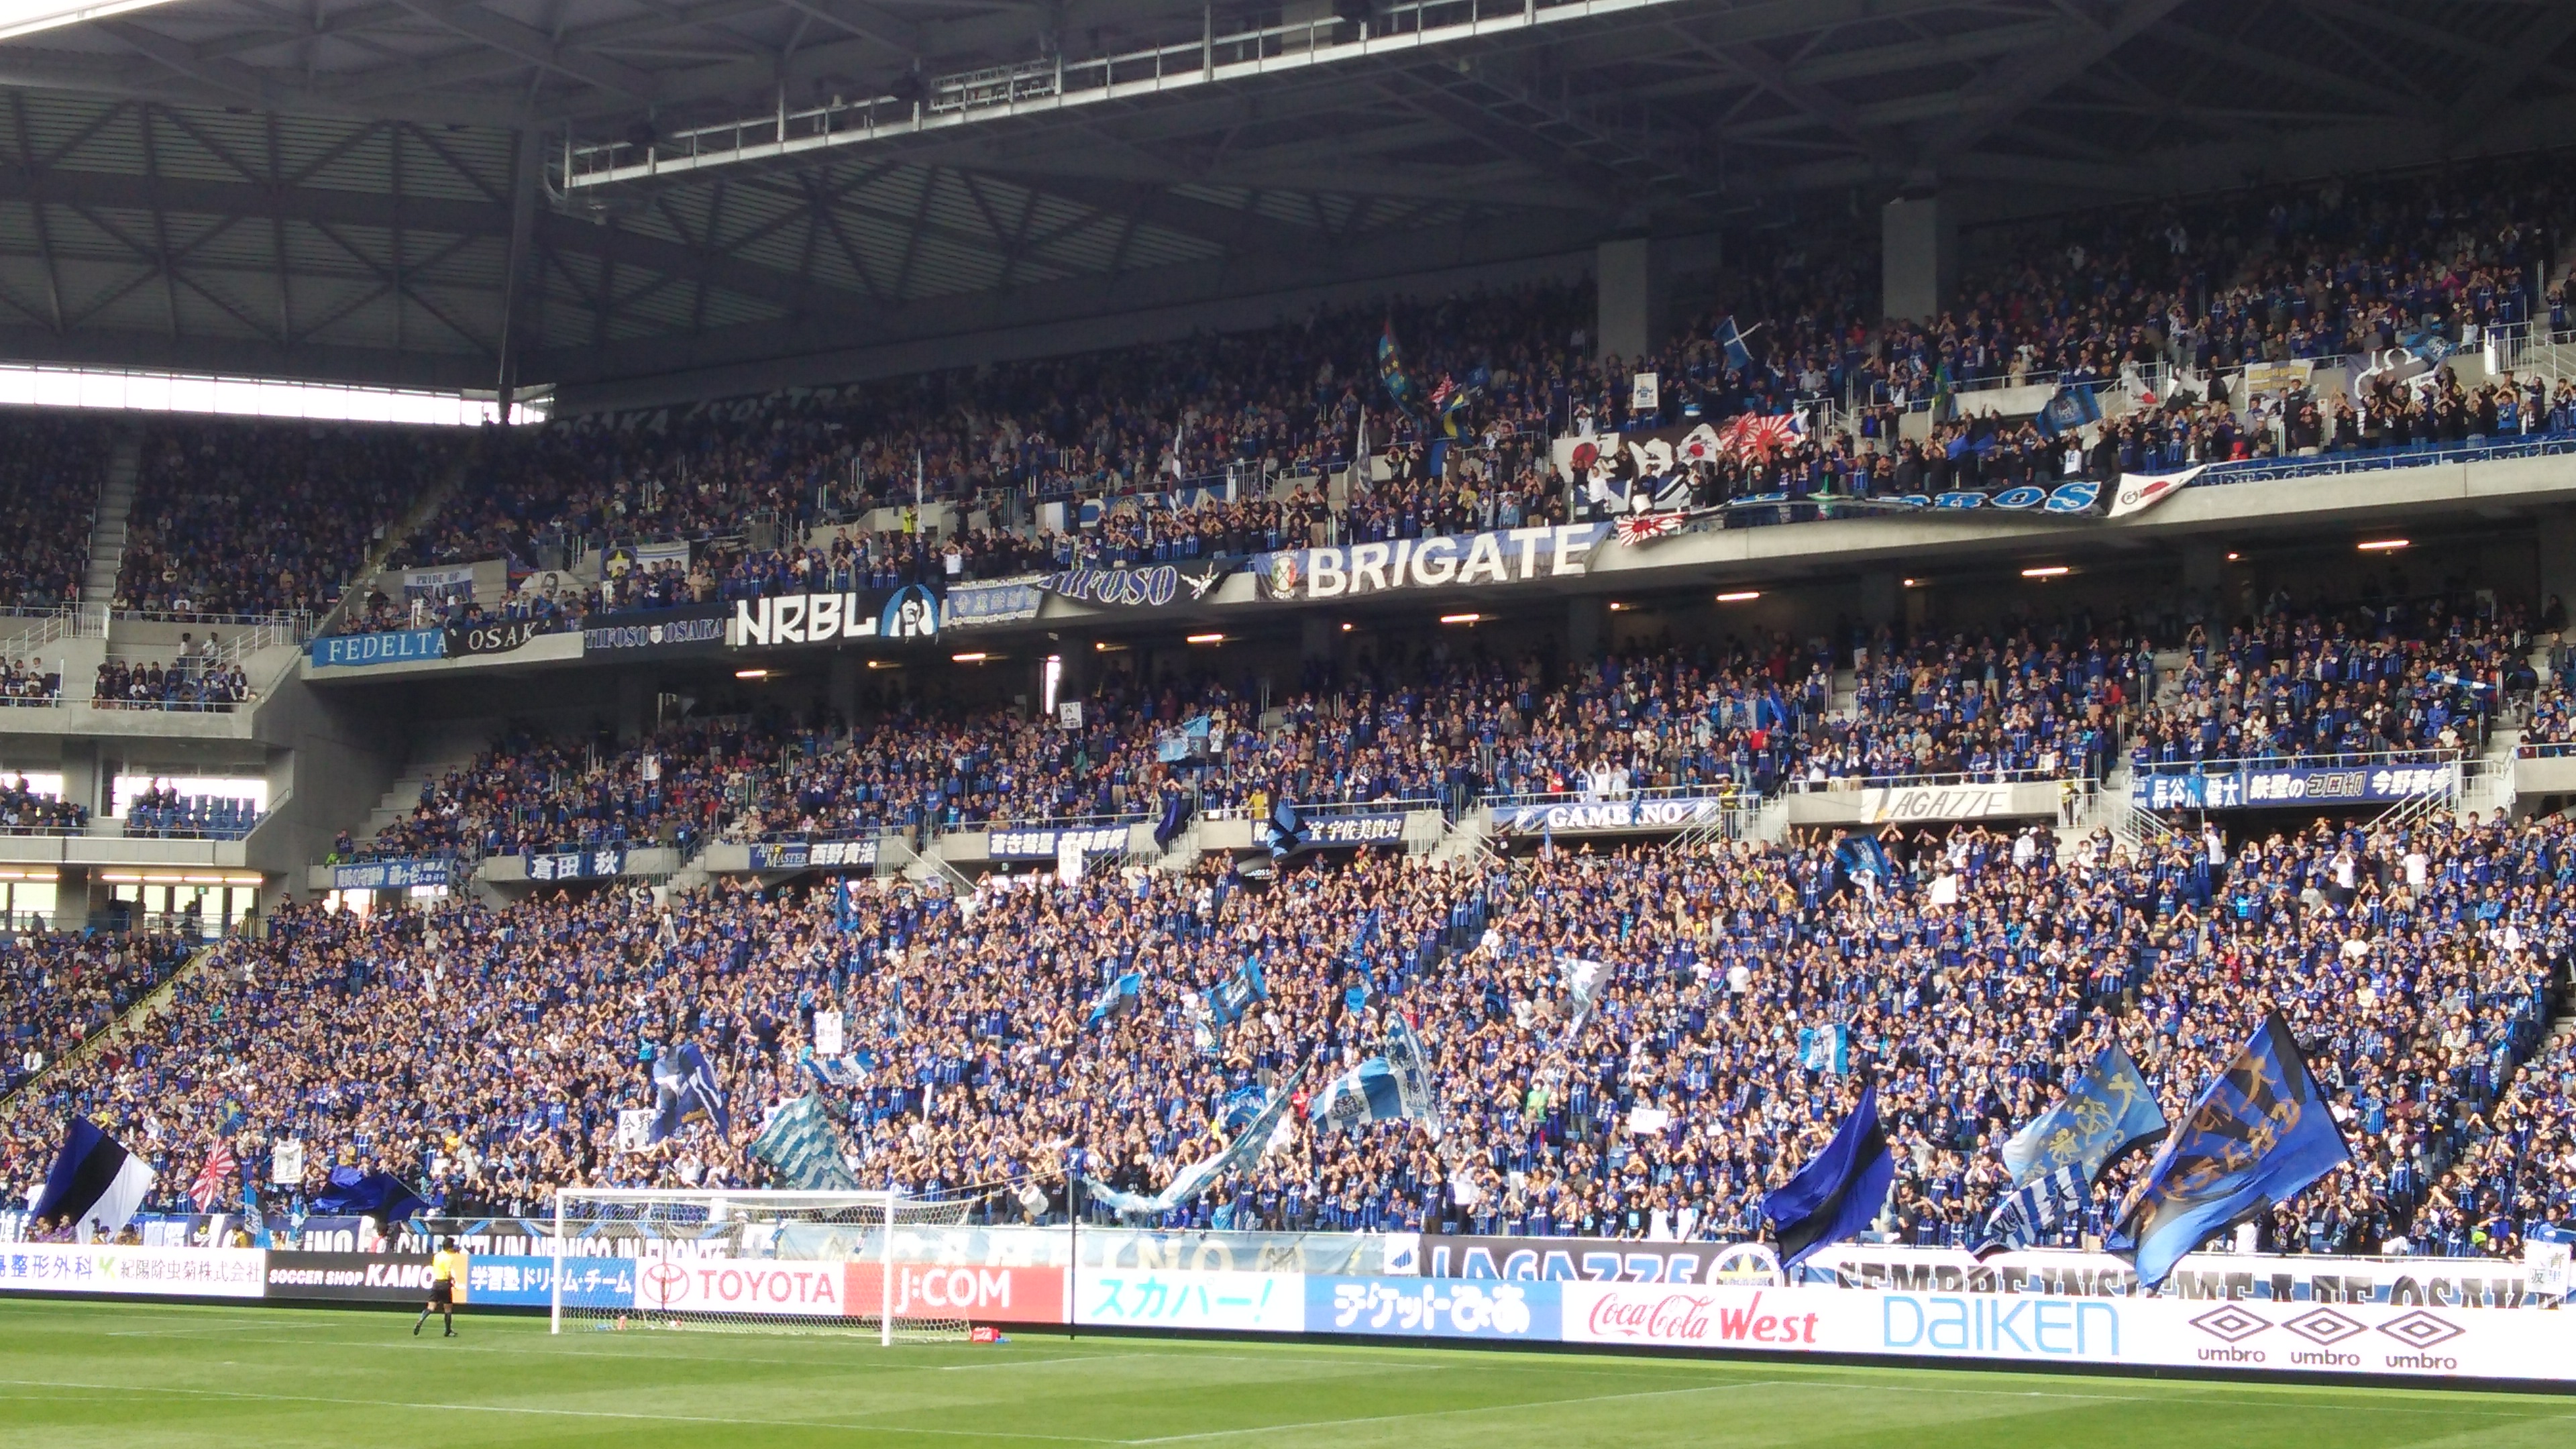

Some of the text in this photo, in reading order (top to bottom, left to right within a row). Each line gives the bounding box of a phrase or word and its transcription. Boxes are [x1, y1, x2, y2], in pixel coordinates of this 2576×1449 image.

[1308, 523, 1593, 597] BRIGATE
[417, 574, 444, 585] PRIDE
[737, 592, 876, 645] NRBL
[585, 617, 724, 649] TIFOSO OSAKA
[1548, 802, 1683, 828] GAMBNO
[1328, 818, 1401, 841] 宇佐美貴史
[594, 851, 620, 875] 秋
[121, 1257, 262, 1284] 紀陽除虫菊株式会社
[269, 1263, 435, 1289] SOCCER SHOP KAMO
[698, 1269, 836, 1303] TOYOTA
[896, 1268, 1010, 1314] J:COM
[1091, 1277, 1274, 1322] スカパー!
[1334, 1282, 1530, 1334] チケットぴあ
[1588, 1291, 1819, 1343] Coca-Cola West
[2198, 1346, 2266, 1363] umbro
[2290, 1348, 2361, 1367] umbro
[2385, 1352, 2457, 1370] umbro
